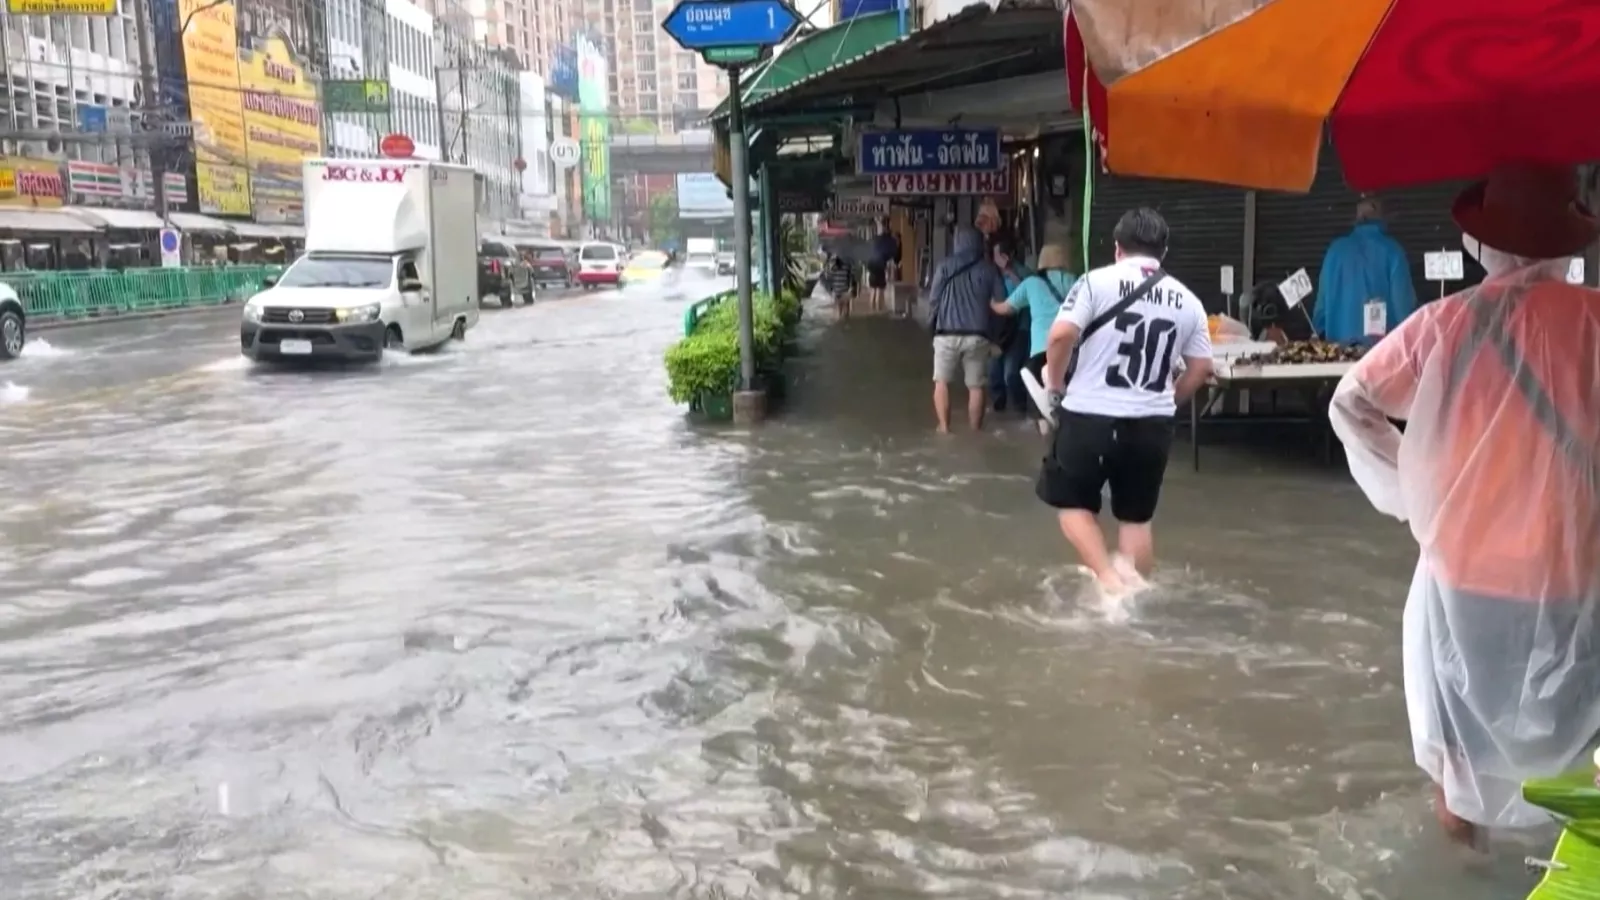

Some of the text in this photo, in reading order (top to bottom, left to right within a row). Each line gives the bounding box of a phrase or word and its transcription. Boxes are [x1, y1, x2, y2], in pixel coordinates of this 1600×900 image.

[686, 6, 775, 29] อ่อนนุช 1
[872, 136, 923, 167] ทำฟัน
[937, 134, 989, 165] จัดฟัน
[361, 168, 373, 182] &
[376, 164, 408, 183] JOY
[1119, 279, 1183, 310] MIAN FC
[1105, 311, 1177, 393] 30
